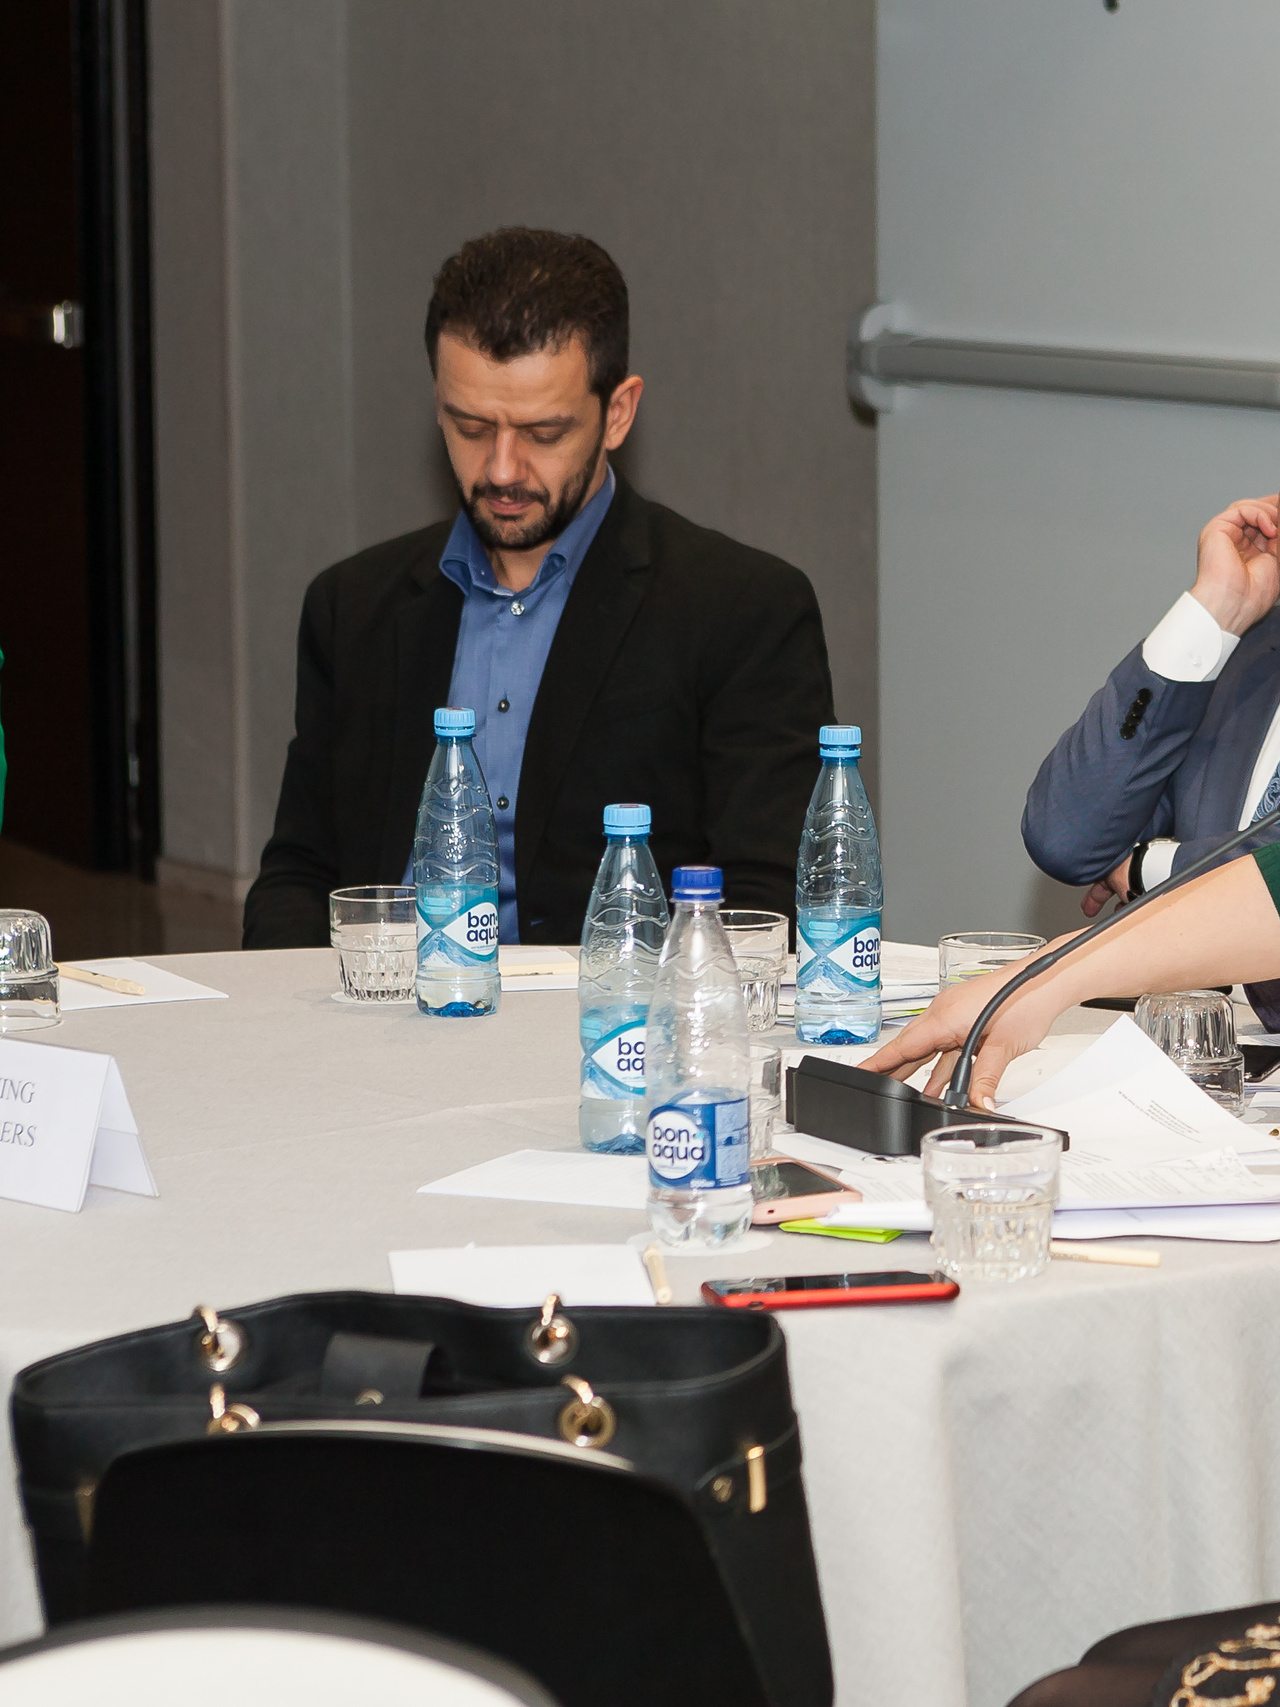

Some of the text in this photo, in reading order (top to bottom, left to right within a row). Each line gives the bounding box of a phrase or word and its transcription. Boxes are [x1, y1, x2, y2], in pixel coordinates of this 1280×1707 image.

[467, 911, 496, 929] bon
[853, 936, 880, 954] bon
[852, 952, 880, 971] aqu
[618, 1037, 645, 1056] bo
[617, 1057, 645, 1076] aq
[0, 1078, 35, 1104] ING
[652, 1120, 690, 1143] bon
[652, 1143, 704, 1166] aqua
